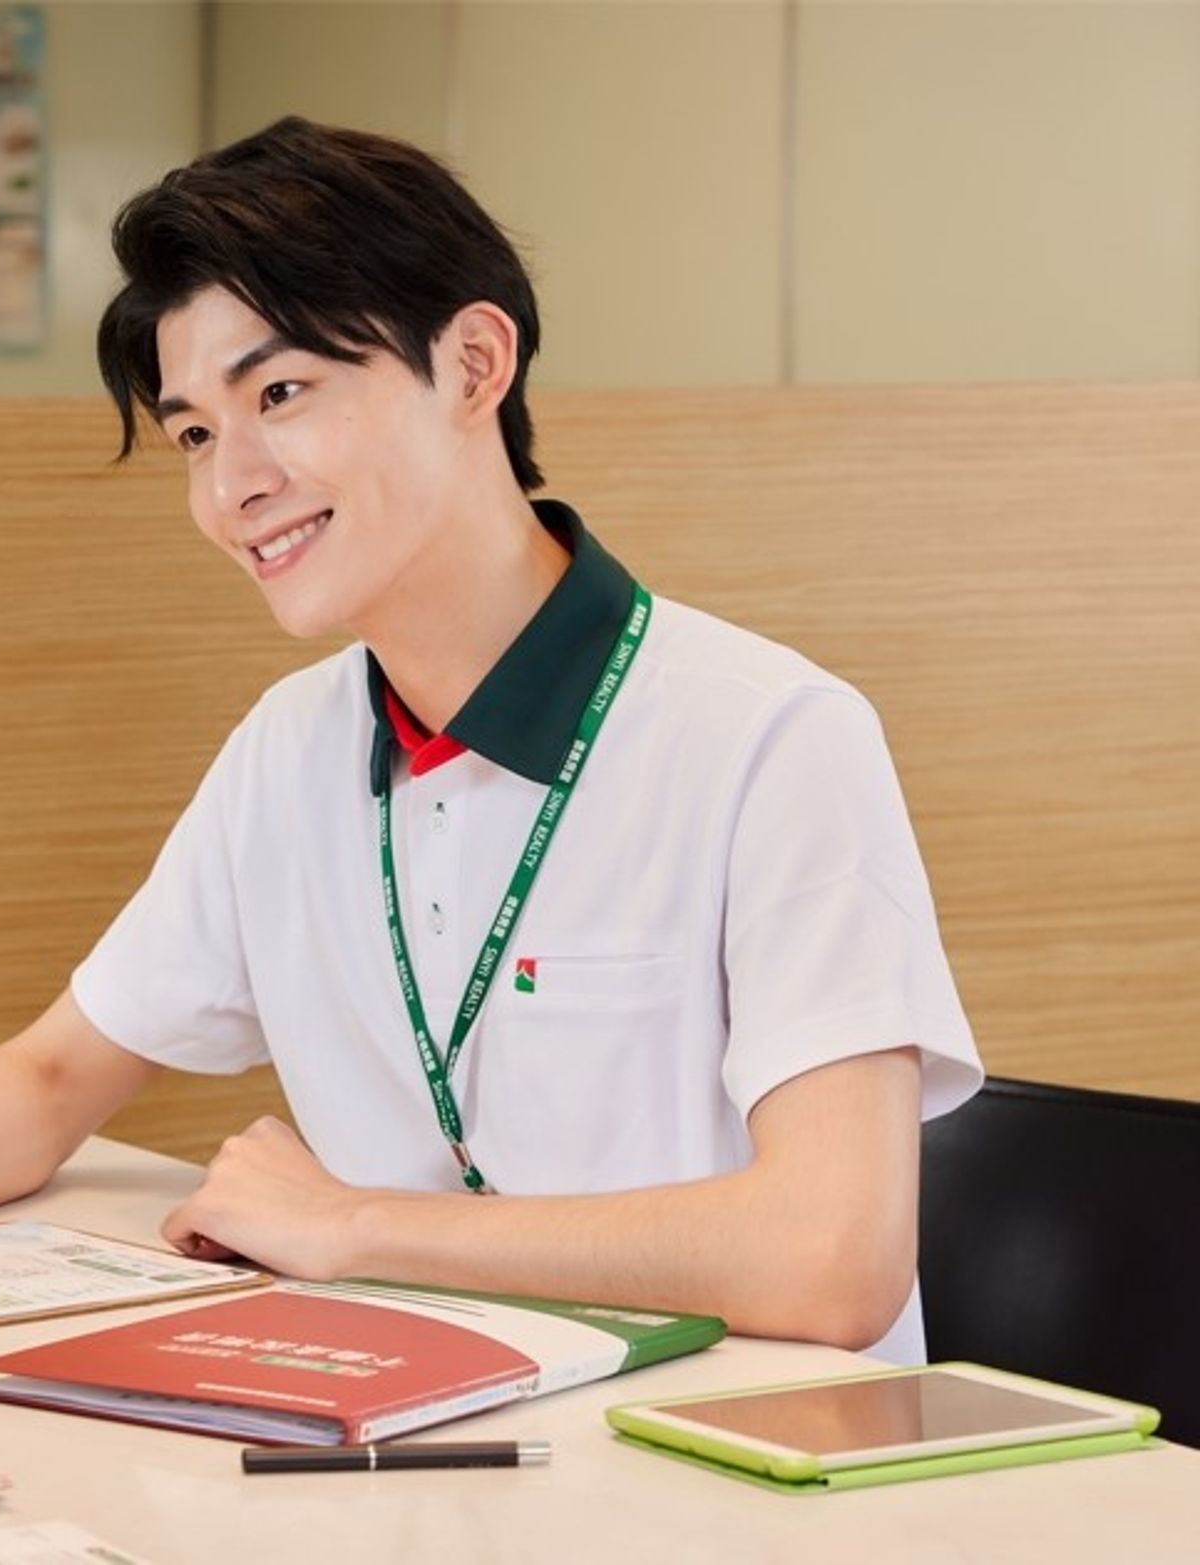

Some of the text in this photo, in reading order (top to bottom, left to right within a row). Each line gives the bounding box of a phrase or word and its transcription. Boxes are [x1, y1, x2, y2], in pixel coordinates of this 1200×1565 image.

[591, 642, 634, 714] SINYI REALTY
[523, 824, 550, 868] REALTY
[461, 946, 499, 1019] SINYI REALTY
